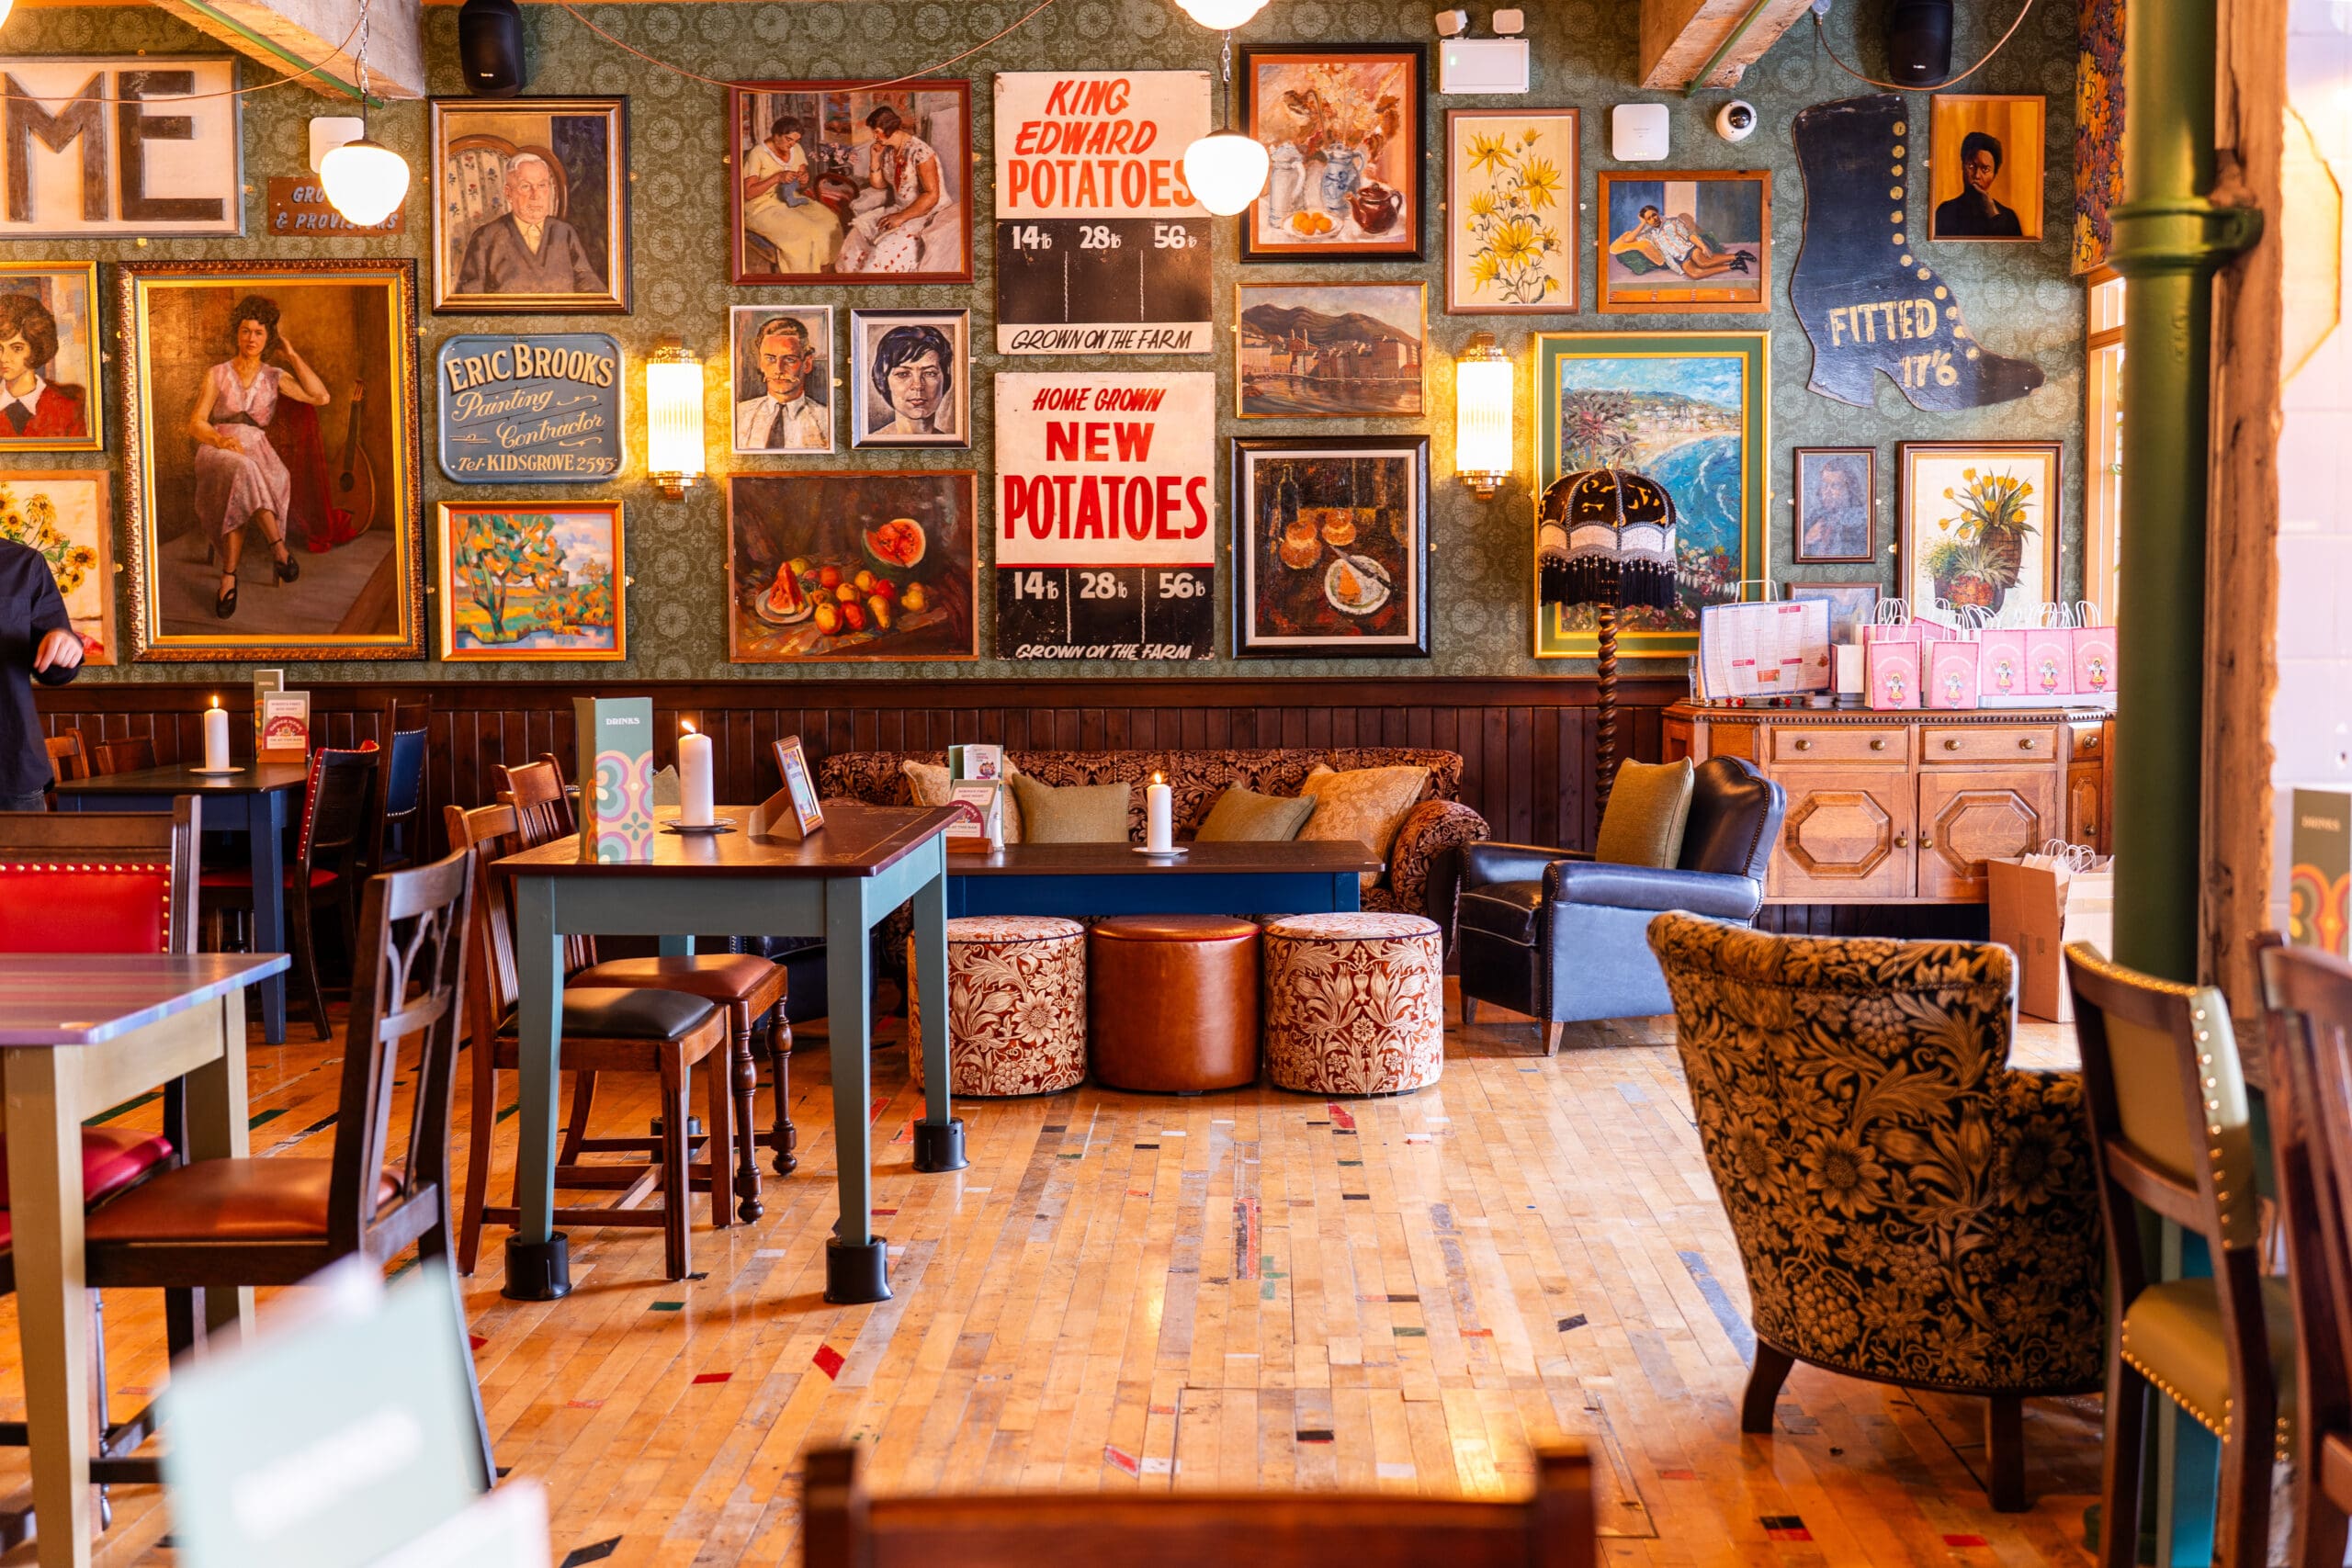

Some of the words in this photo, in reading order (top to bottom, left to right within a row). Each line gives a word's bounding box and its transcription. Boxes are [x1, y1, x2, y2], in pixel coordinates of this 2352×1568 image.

[1045, 78, 1131, 117] KING
[1014, 119, 1158, 156] EDWARD
[276, 211, 288, 230] &
[1011, 330, 1086, 350] GROWN
[1084, 330, 1109, 350] ON
[1107, 330, 1138, 349] THE
[1136, 329, 1193, 350] FARM
[1828, 299, 1938, 347] FITTED
[446, 350, 512, 396] ERIC
[511, 344, 616, 389] BROOKS
[451, 389, 555, 422] Painting
[1032, 388, 1092, 412] HOME
[1093, 388, 1168, 412] GROWN
[496, 411, 606, 449] Contractor
[1046, 421, 1155, 462] NEW
[486, 454, 574, 471] KIDSGROVE
[576, 457, 616, 474] 2593
[1003, 474, 1208, 541] POTATOES
[1014, 643, 1087, 660] GROWN
[1085, 644, 1112, 660] ON
[1110, 643, 1140, 660] THE
[1141, 644, 1193, 660] FARM
[605, 717, 640, 726] DRINKS
